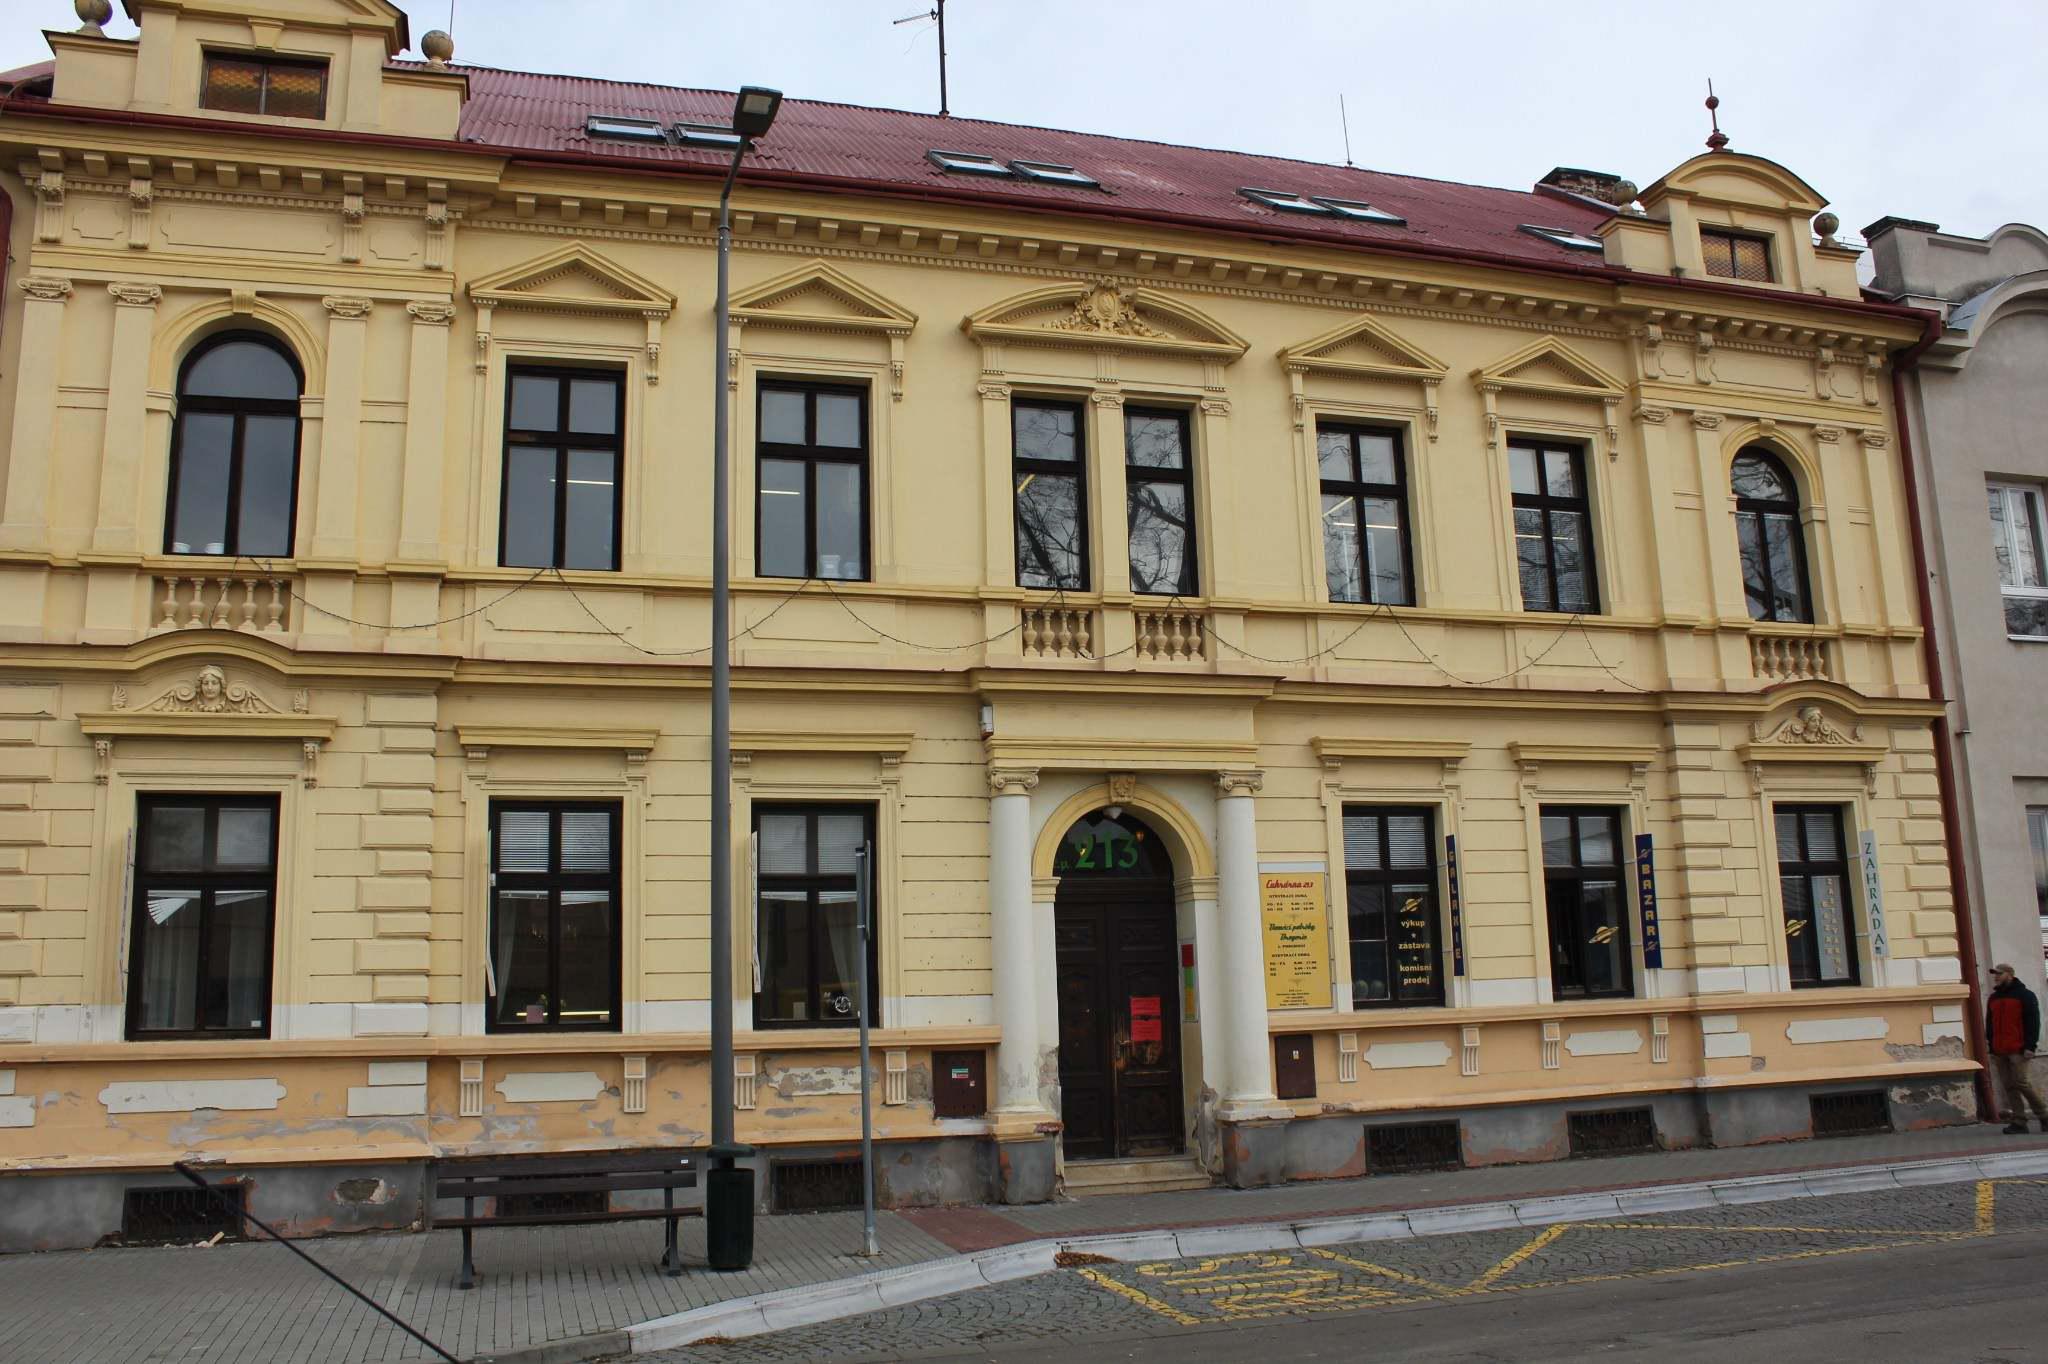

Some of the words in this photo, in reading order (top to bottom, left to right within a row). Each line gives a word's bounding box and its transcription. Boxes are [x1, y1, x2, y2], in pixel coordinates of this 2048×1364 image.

[1074, 832, 1139, 869] 213
[1447, 851, 1463, 959] GALAXIE
[1641, 864, 1657, 937] BAZAR
[1864, 842, 1885, 945] ZAHRADA
[1400, 918, 1425, 929] výkup
[1403, 975, 1431, 986] prodej
